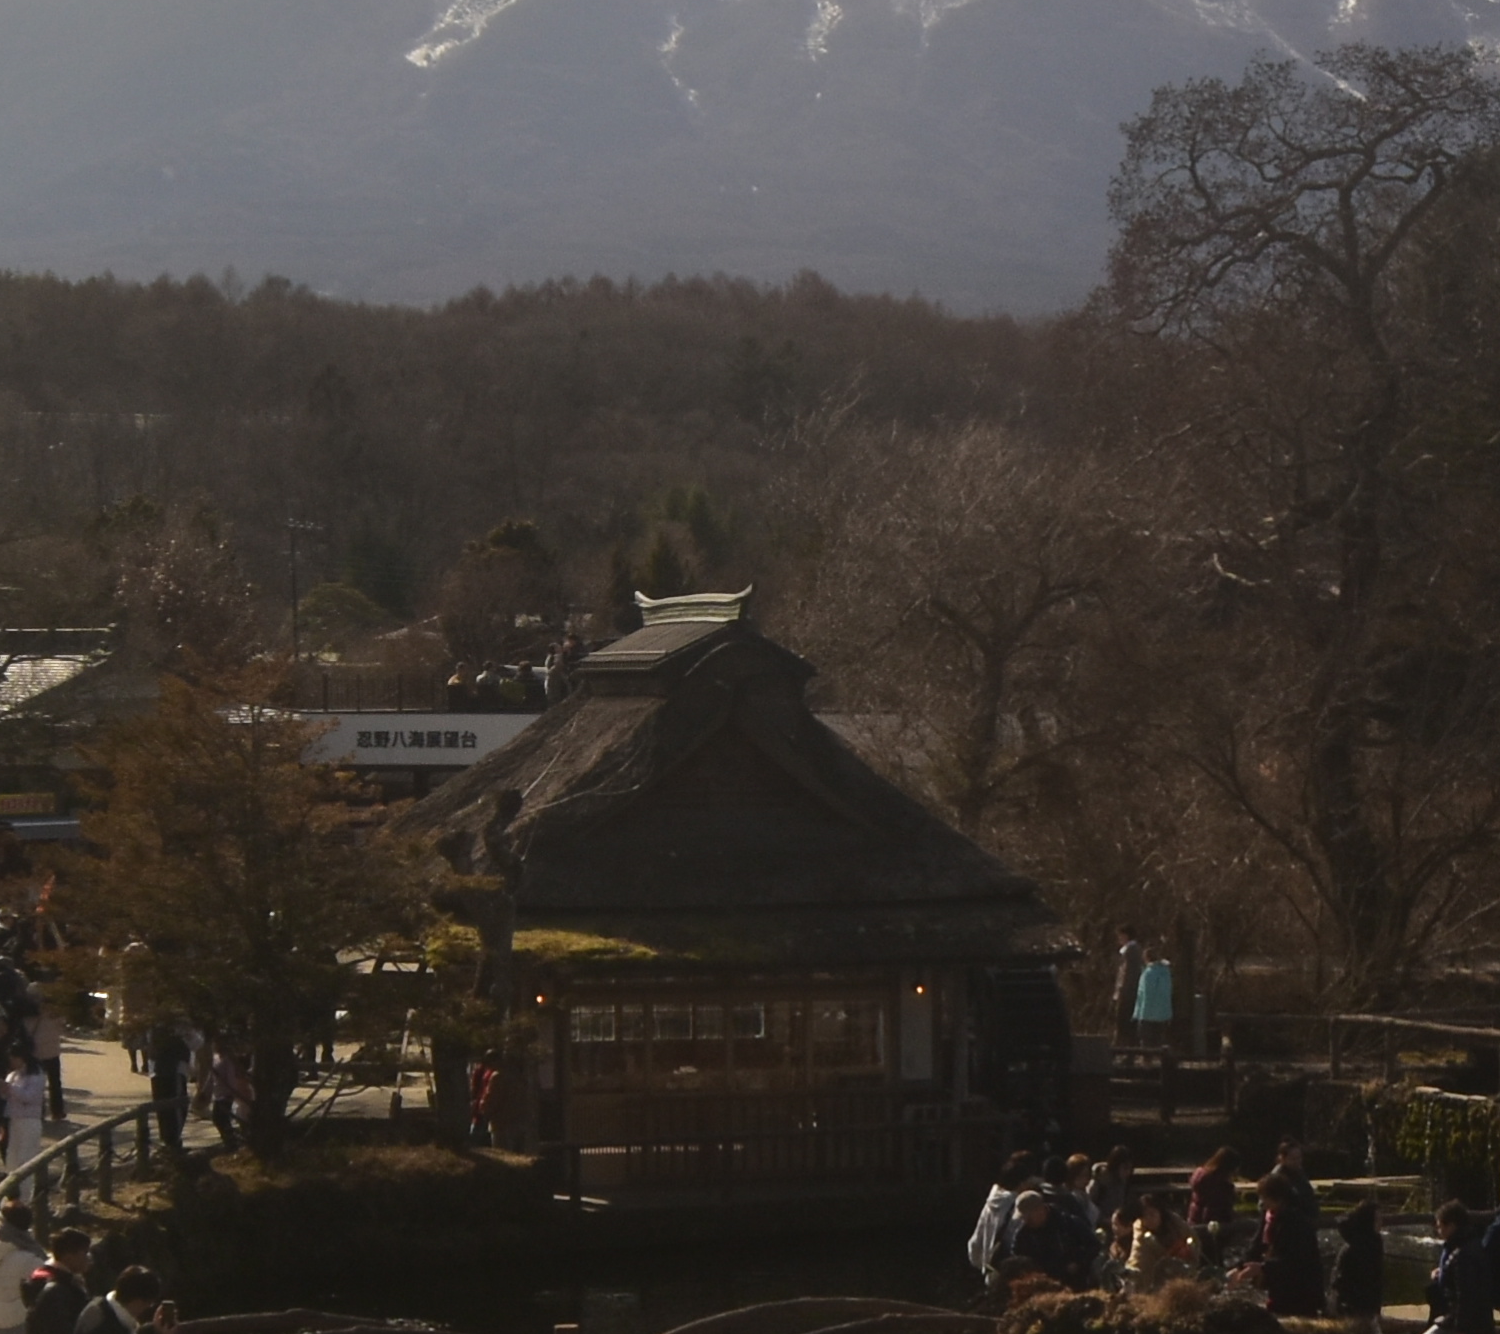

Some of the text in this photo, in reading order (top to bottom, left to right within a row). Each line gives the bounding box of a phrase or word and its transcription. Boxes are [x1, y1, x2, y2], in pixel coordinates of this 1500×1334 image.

[357, 731, 477, 748] 忍野八海展望台
